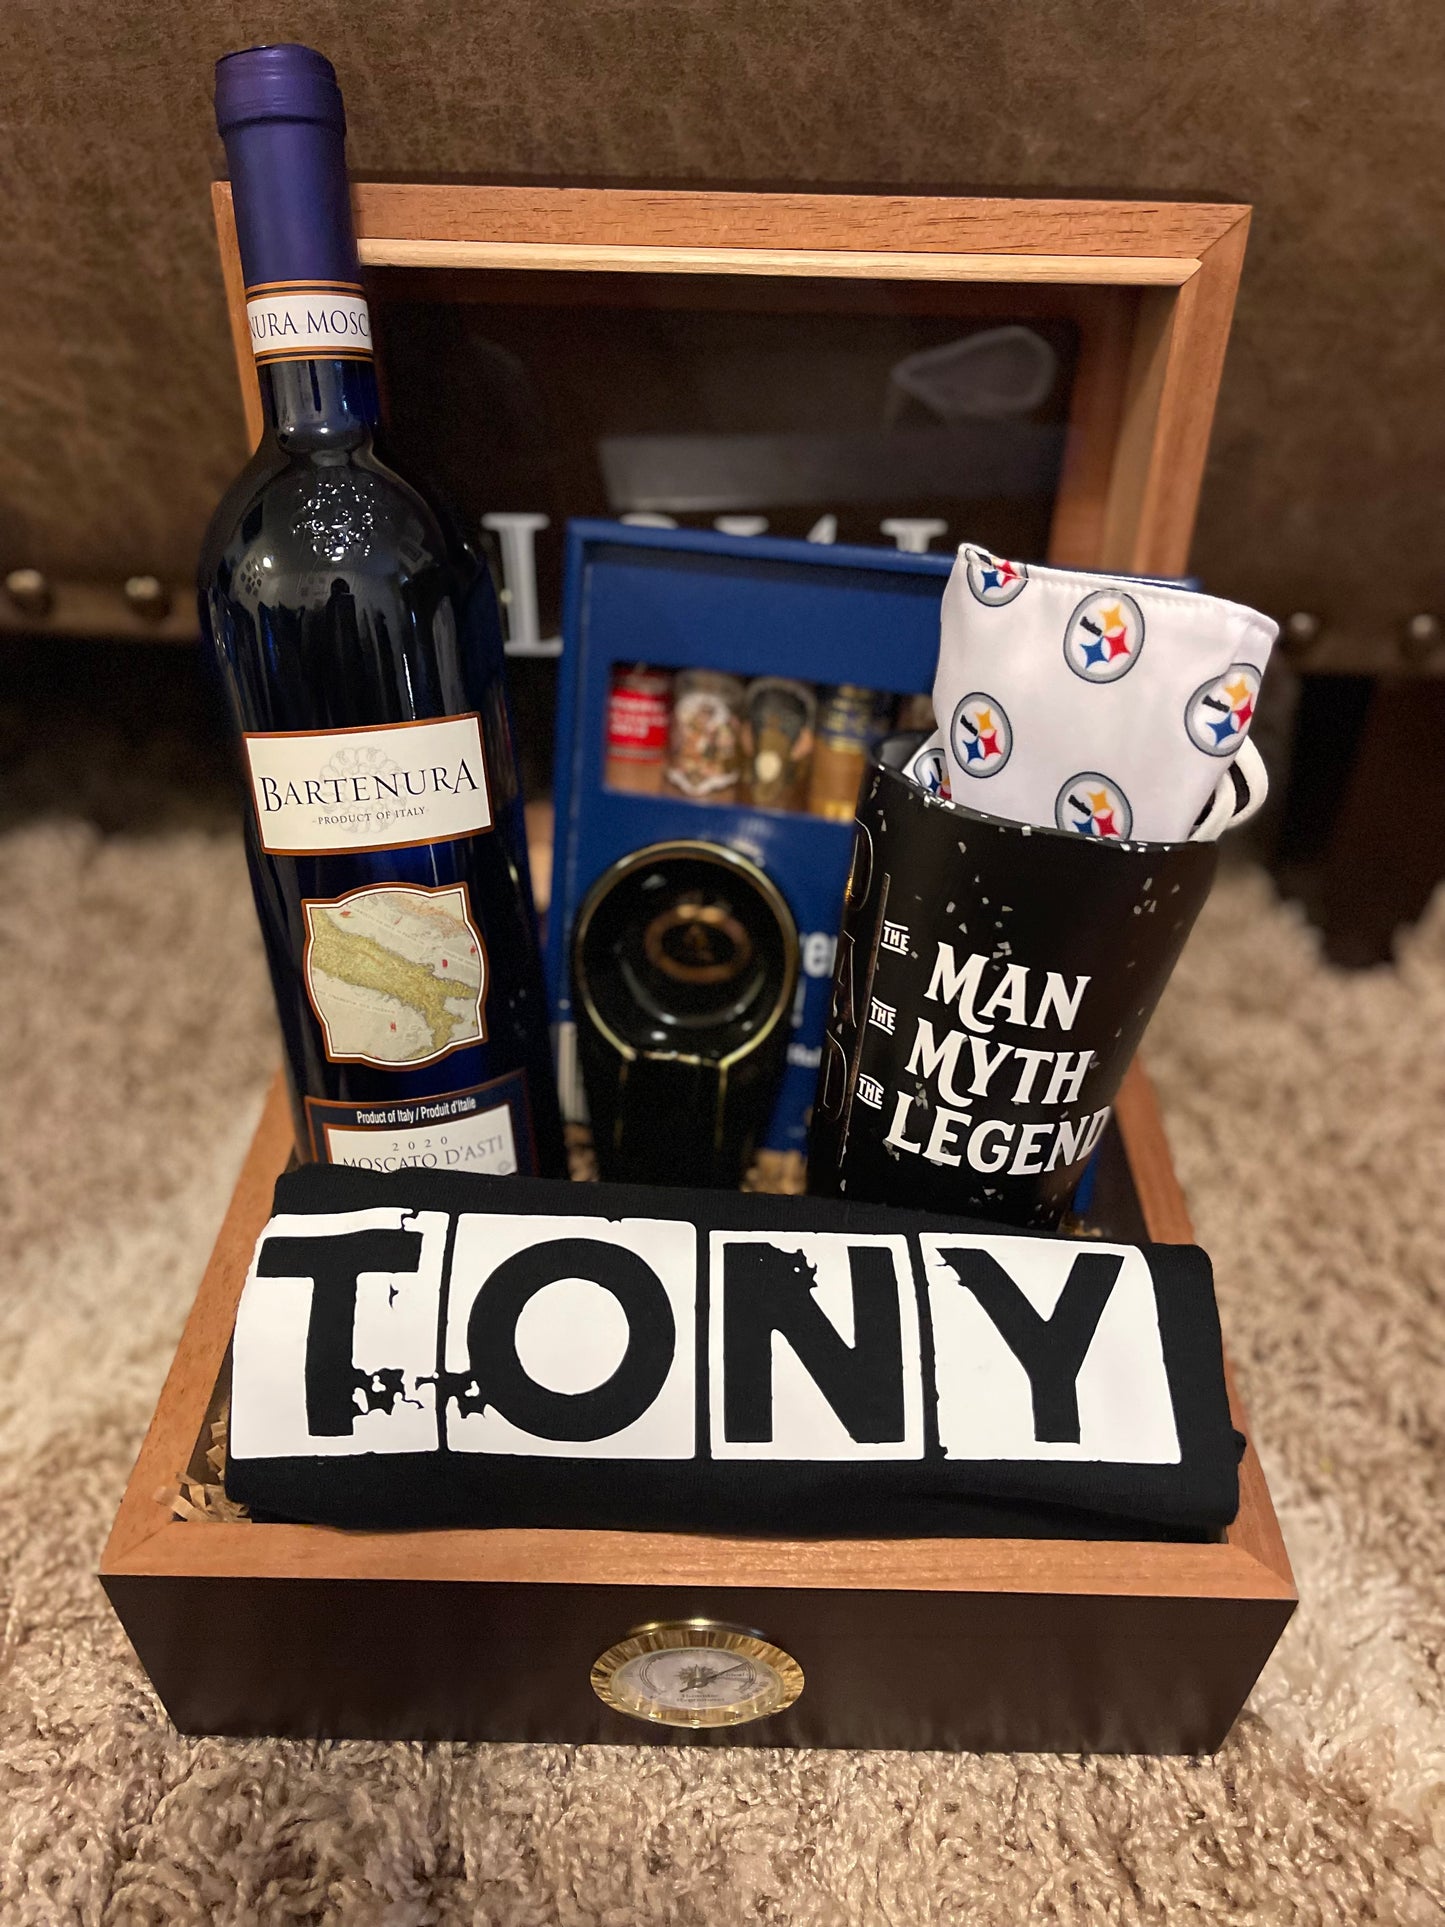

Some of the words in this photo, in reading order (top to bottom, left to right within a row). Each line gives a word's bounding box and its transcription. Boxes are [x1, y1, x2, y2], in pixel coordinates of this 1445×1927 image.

[258, 758, 480, 813] BARTENURA
[376, 810, 391, 820] OF
[883, 925, 911, 952] THE
[923, 941, 1092, 1033] MAN
[871, 1001, 897, 1031] THE
[905, 1017, 1096, 1108] MYTH
[356, 1110, 387, 1124] Product
[388, 1109, 397, 1123] of
[397, 1108, 414, 1124] Italy
[420, 1102, 450, 1119] Produit
[451, 1096, 477, 1114] d'Italie
[858, 1077, 884, 1106] THE
[884, 1090, 1112, 1176] LEGEND
[343, 1153, 438, 1172] MOSCATO
[445, 1135, 504, 1165] D'ASTI
[255, 1227, 1125, 1444] TONY
